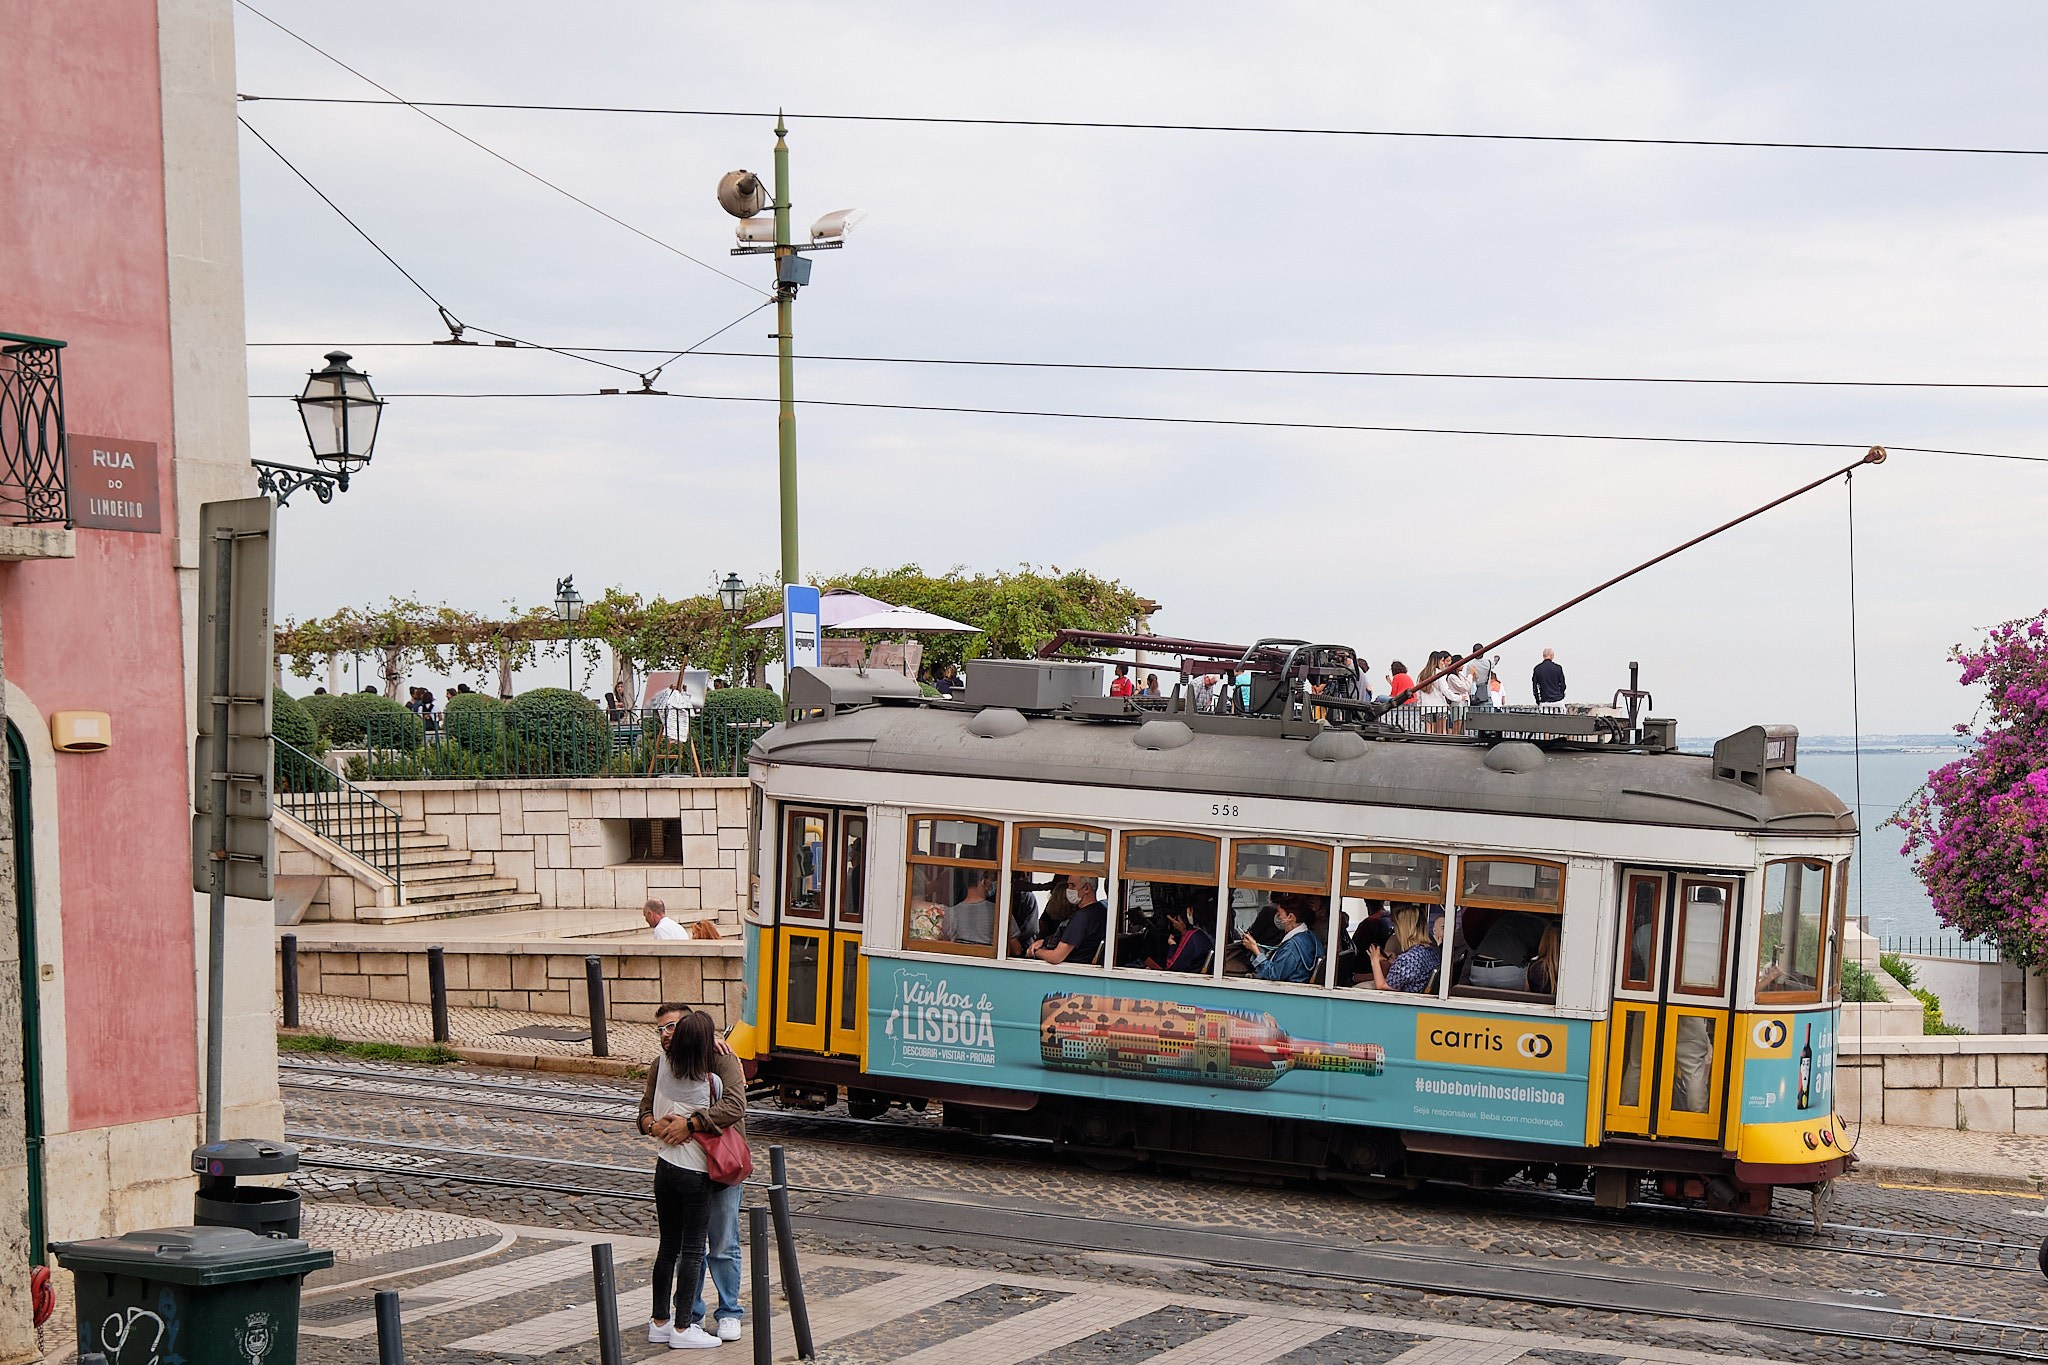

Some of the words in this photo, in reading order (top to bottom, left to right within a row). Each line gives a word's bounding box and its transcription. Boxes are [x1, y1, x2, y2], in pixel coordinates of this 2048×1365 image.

[93, 449, 135, 469] RUA
[108, 479, 123, 489] DO
[1211, 804, 1239, 817] 558
[903, 980, 973, 1009] Vinhos
[977, 993, 994, 1011] de
[903, 1005, 995, 1047] LISBOA
[1430, 1027, 1503, 1051] carris
[903, 1046, 938, 1058] DESCOBRIR
[942, 1050, 966, 1061] VISITAR
[970, 1053, 995, 1064] PROVAR
[1415, 1077, 1565, 1105] #eubebovinhosdelisboa
[1413, 1105, 1430, 1116] Seja
[1431, 1107, 1477, 1119] responsável.
[1480, 1112, 1500, 1121] Beba
[1502, 1115, 1519, 1123] com
[1520, 1117, 1565, 1128] moderação.
